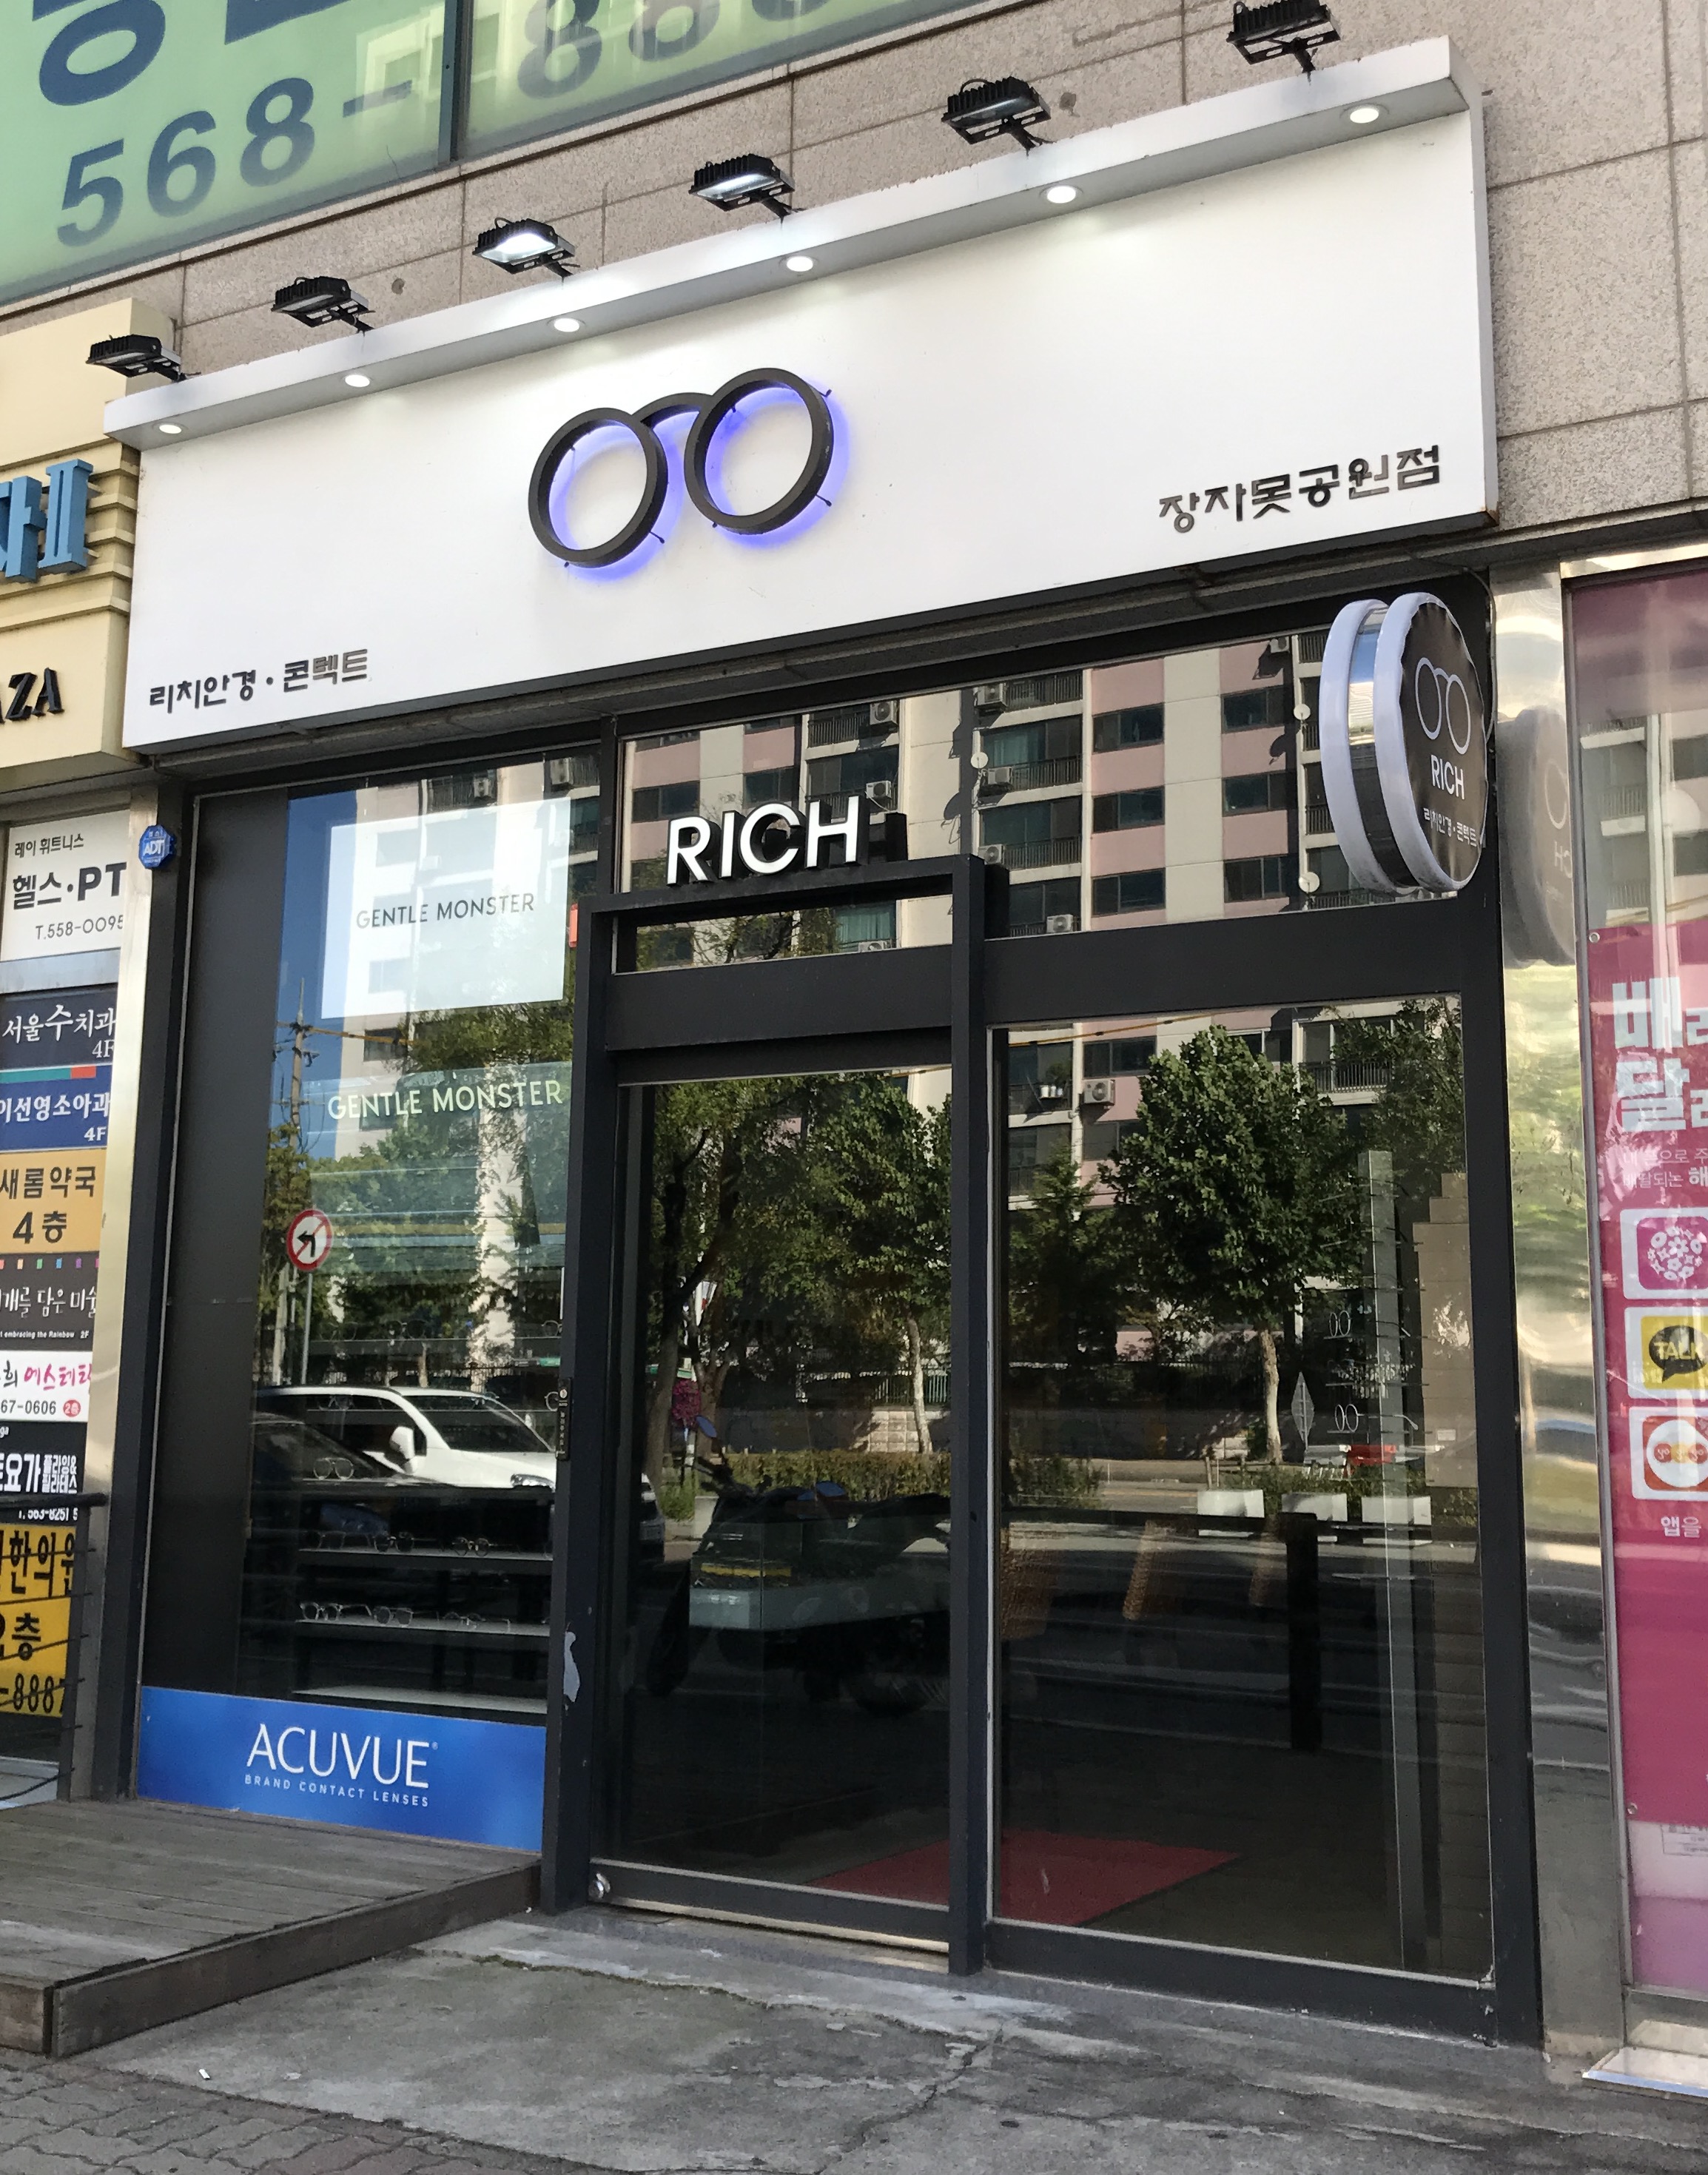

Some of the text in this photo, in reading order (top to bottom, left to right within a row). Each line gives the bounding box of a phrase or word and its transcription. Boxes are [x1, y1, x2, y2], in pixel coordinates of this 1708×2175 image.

[1159, 445, 1440, 533] 장자못공원점
[1430, 754, 1465, 800] RICH
[15, 833, 84, 858] 레이 휘트니스
[144, 839, 164, 855] ADT
[667, 795, 861, 887] RICH
[356, 892, 534, 929] GENTLE MONSTER
[2, 1004, 117, 1043] 서울수치과
[328, 1080, 563, 1120] GENTLE MONSTER
[84, 1126, 106, 1141] 4F
[37, 1286, 66, 1317] 담은
[1653, 1341, 1704, 1360] TALK
[1661, 1516, 1701, 1539] 앱을
[245, 1774, 429, 1807] BRAND CONTACT LENSES
